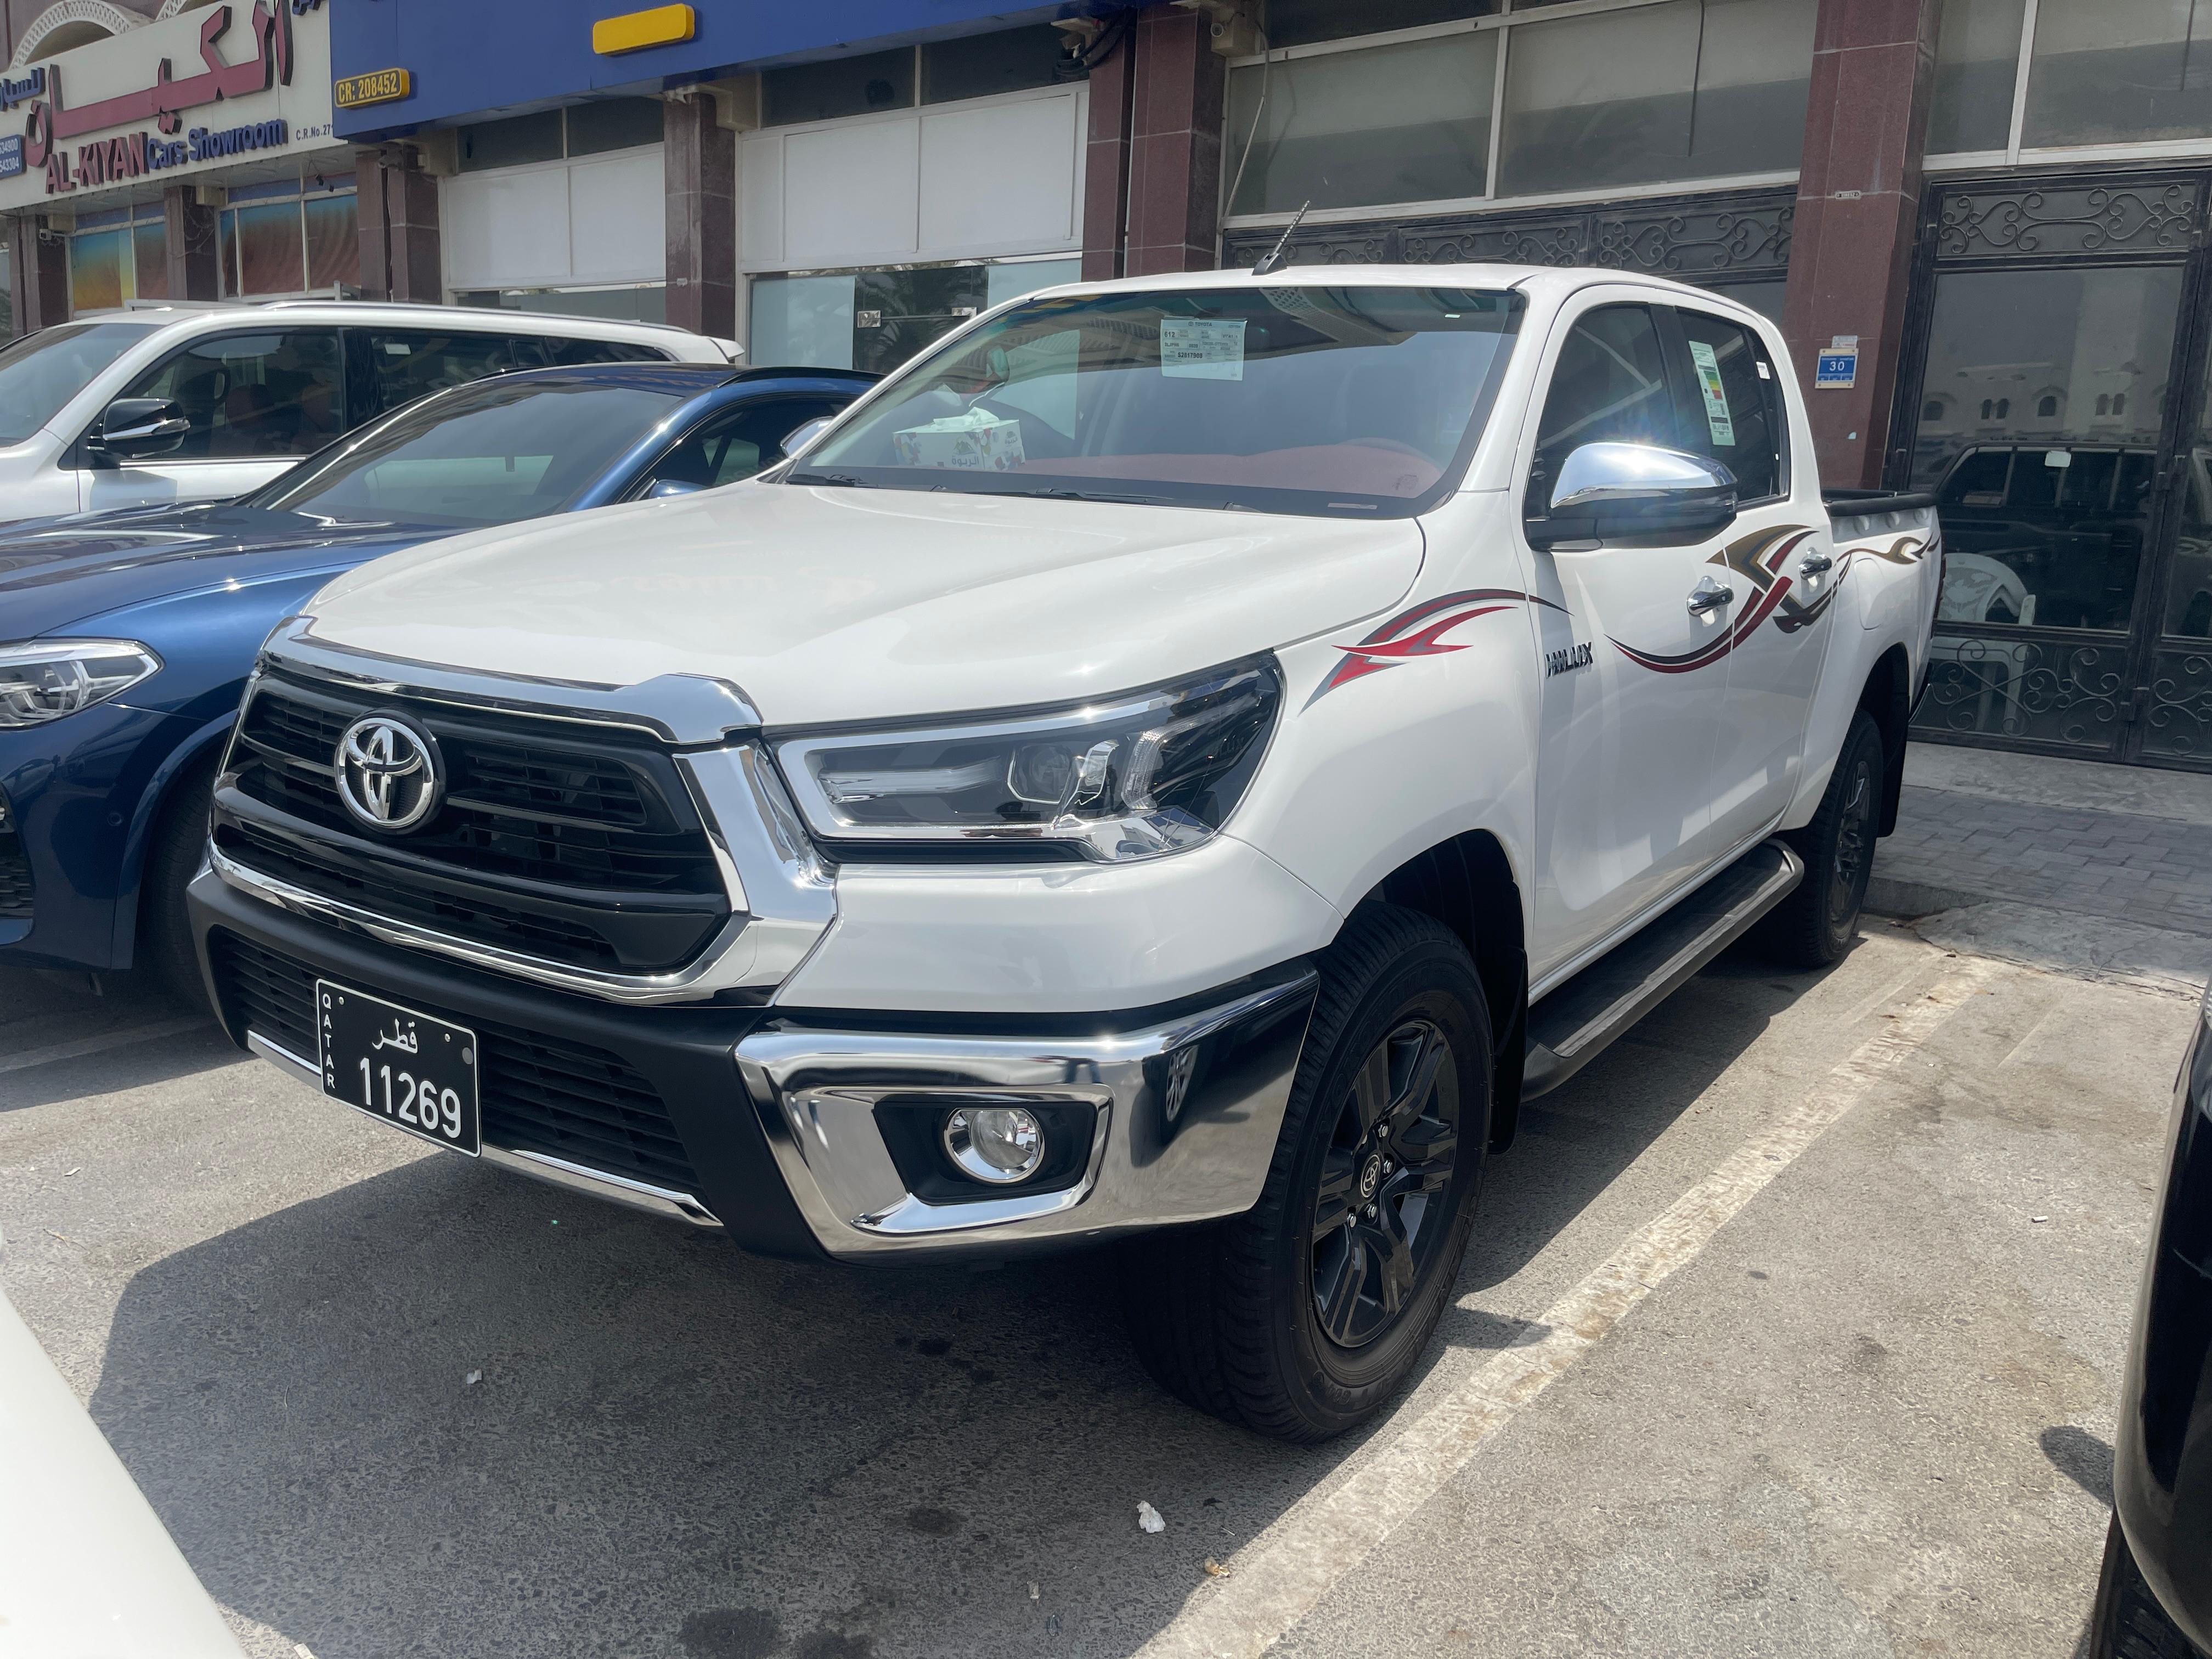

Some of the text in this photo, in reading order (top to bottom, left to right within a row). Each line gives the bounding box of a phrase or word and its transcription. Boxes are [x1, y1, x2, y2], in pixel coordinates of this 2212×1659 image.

[338, 72, 398, 103] CR: 208452
[296, 124, 333, 141] C.R.No.27
[45, 119, 288, 194] AL-KIYAN Cars Showroom
[1829, 361, 1844, 371] 30
[952, 456, 979, 467] الربوة
[1544, 641, 1593, 679] HILUX
[322, 993, 336, 1089] QATAR
[371, 1018, 419, 1054] قطر
[359, 1057, 461, 1139] 11269
